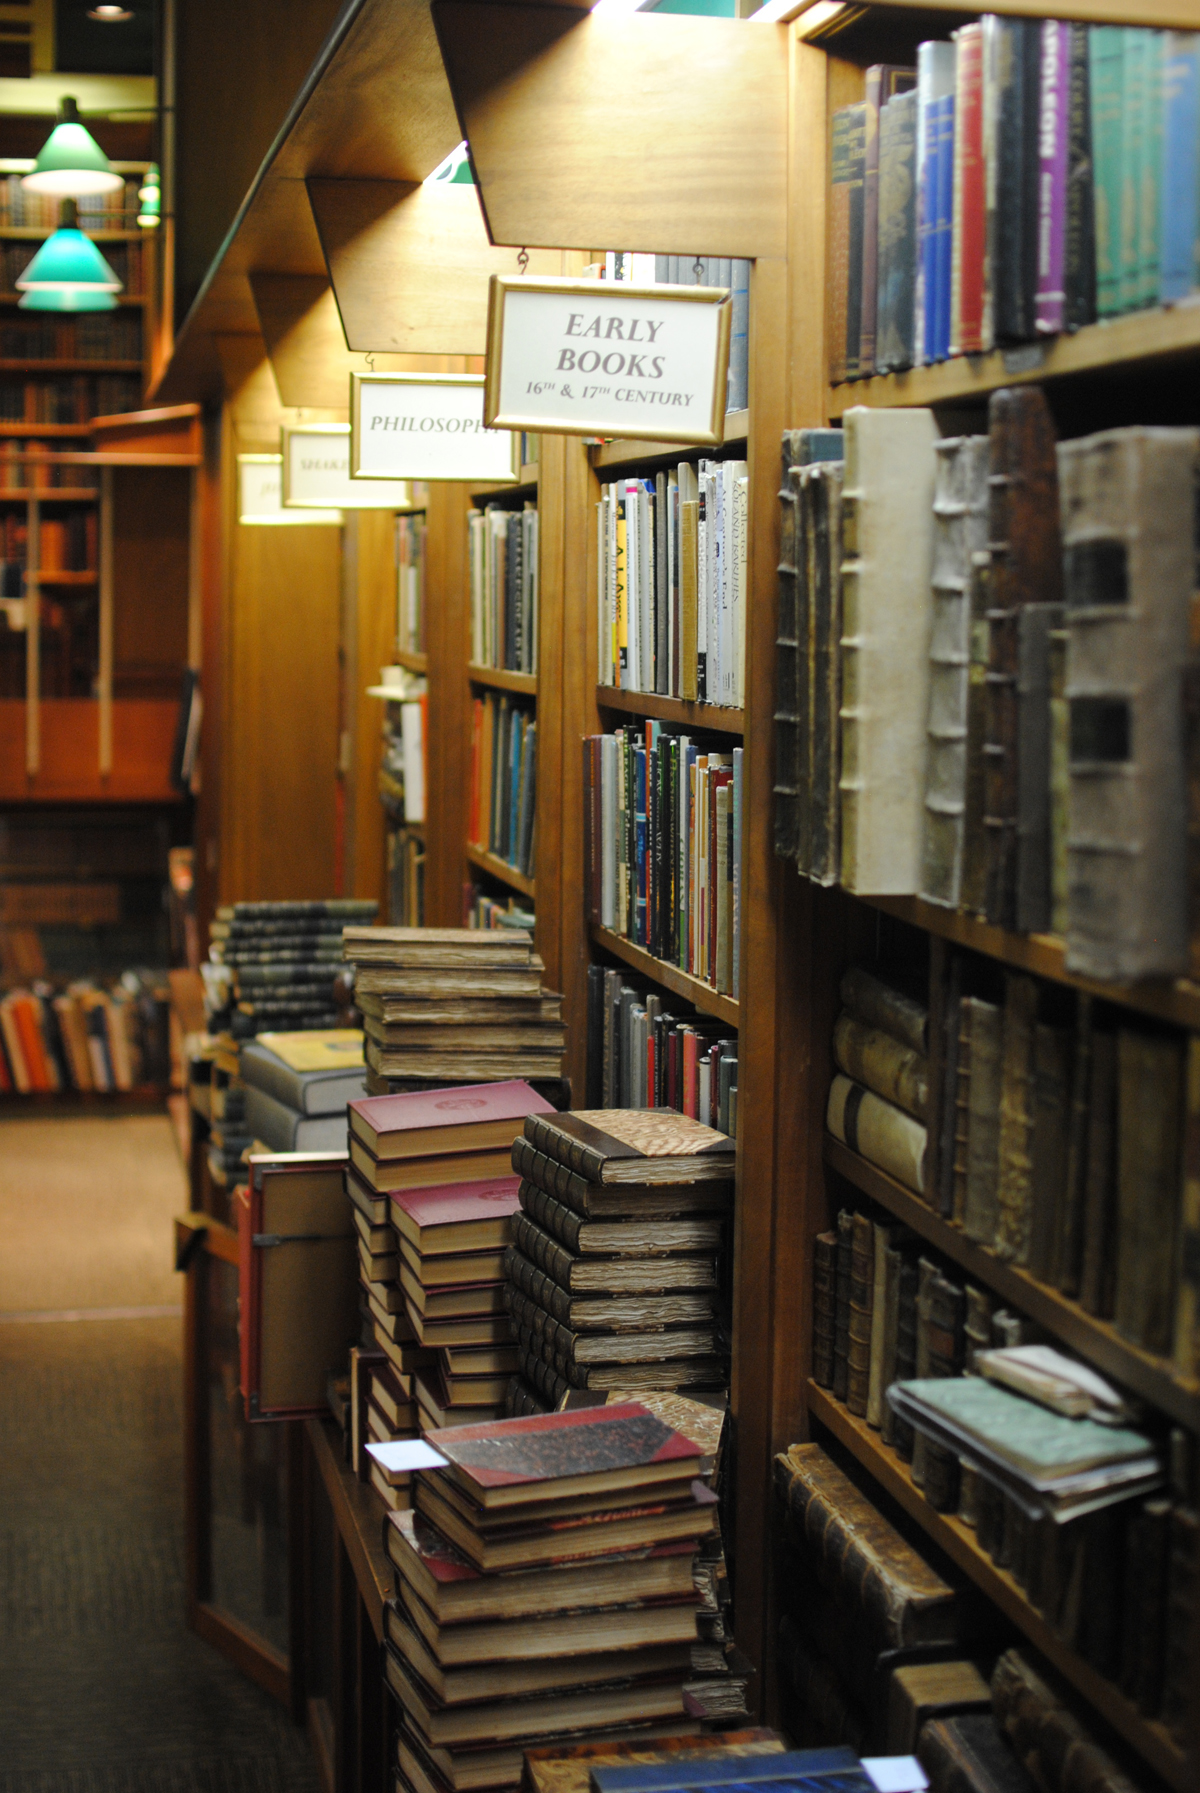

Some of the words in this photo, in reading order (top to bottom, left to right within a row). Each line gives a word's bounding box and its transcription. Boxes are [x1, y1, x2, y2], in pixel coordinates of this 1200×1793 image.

[564, 313, 665, 343] EARLY
[555, 348, 666, 379] BOOKS
[525, 381, 556, 395] 16TH
[560, 383, 575, 399] &
[581, 386, 611, 399] 17TH
[614, 388, 694, 406] CENTURY
[370, 416, 499, 434] PHILOSOPH
[738, 491, 748, 563] Collected
